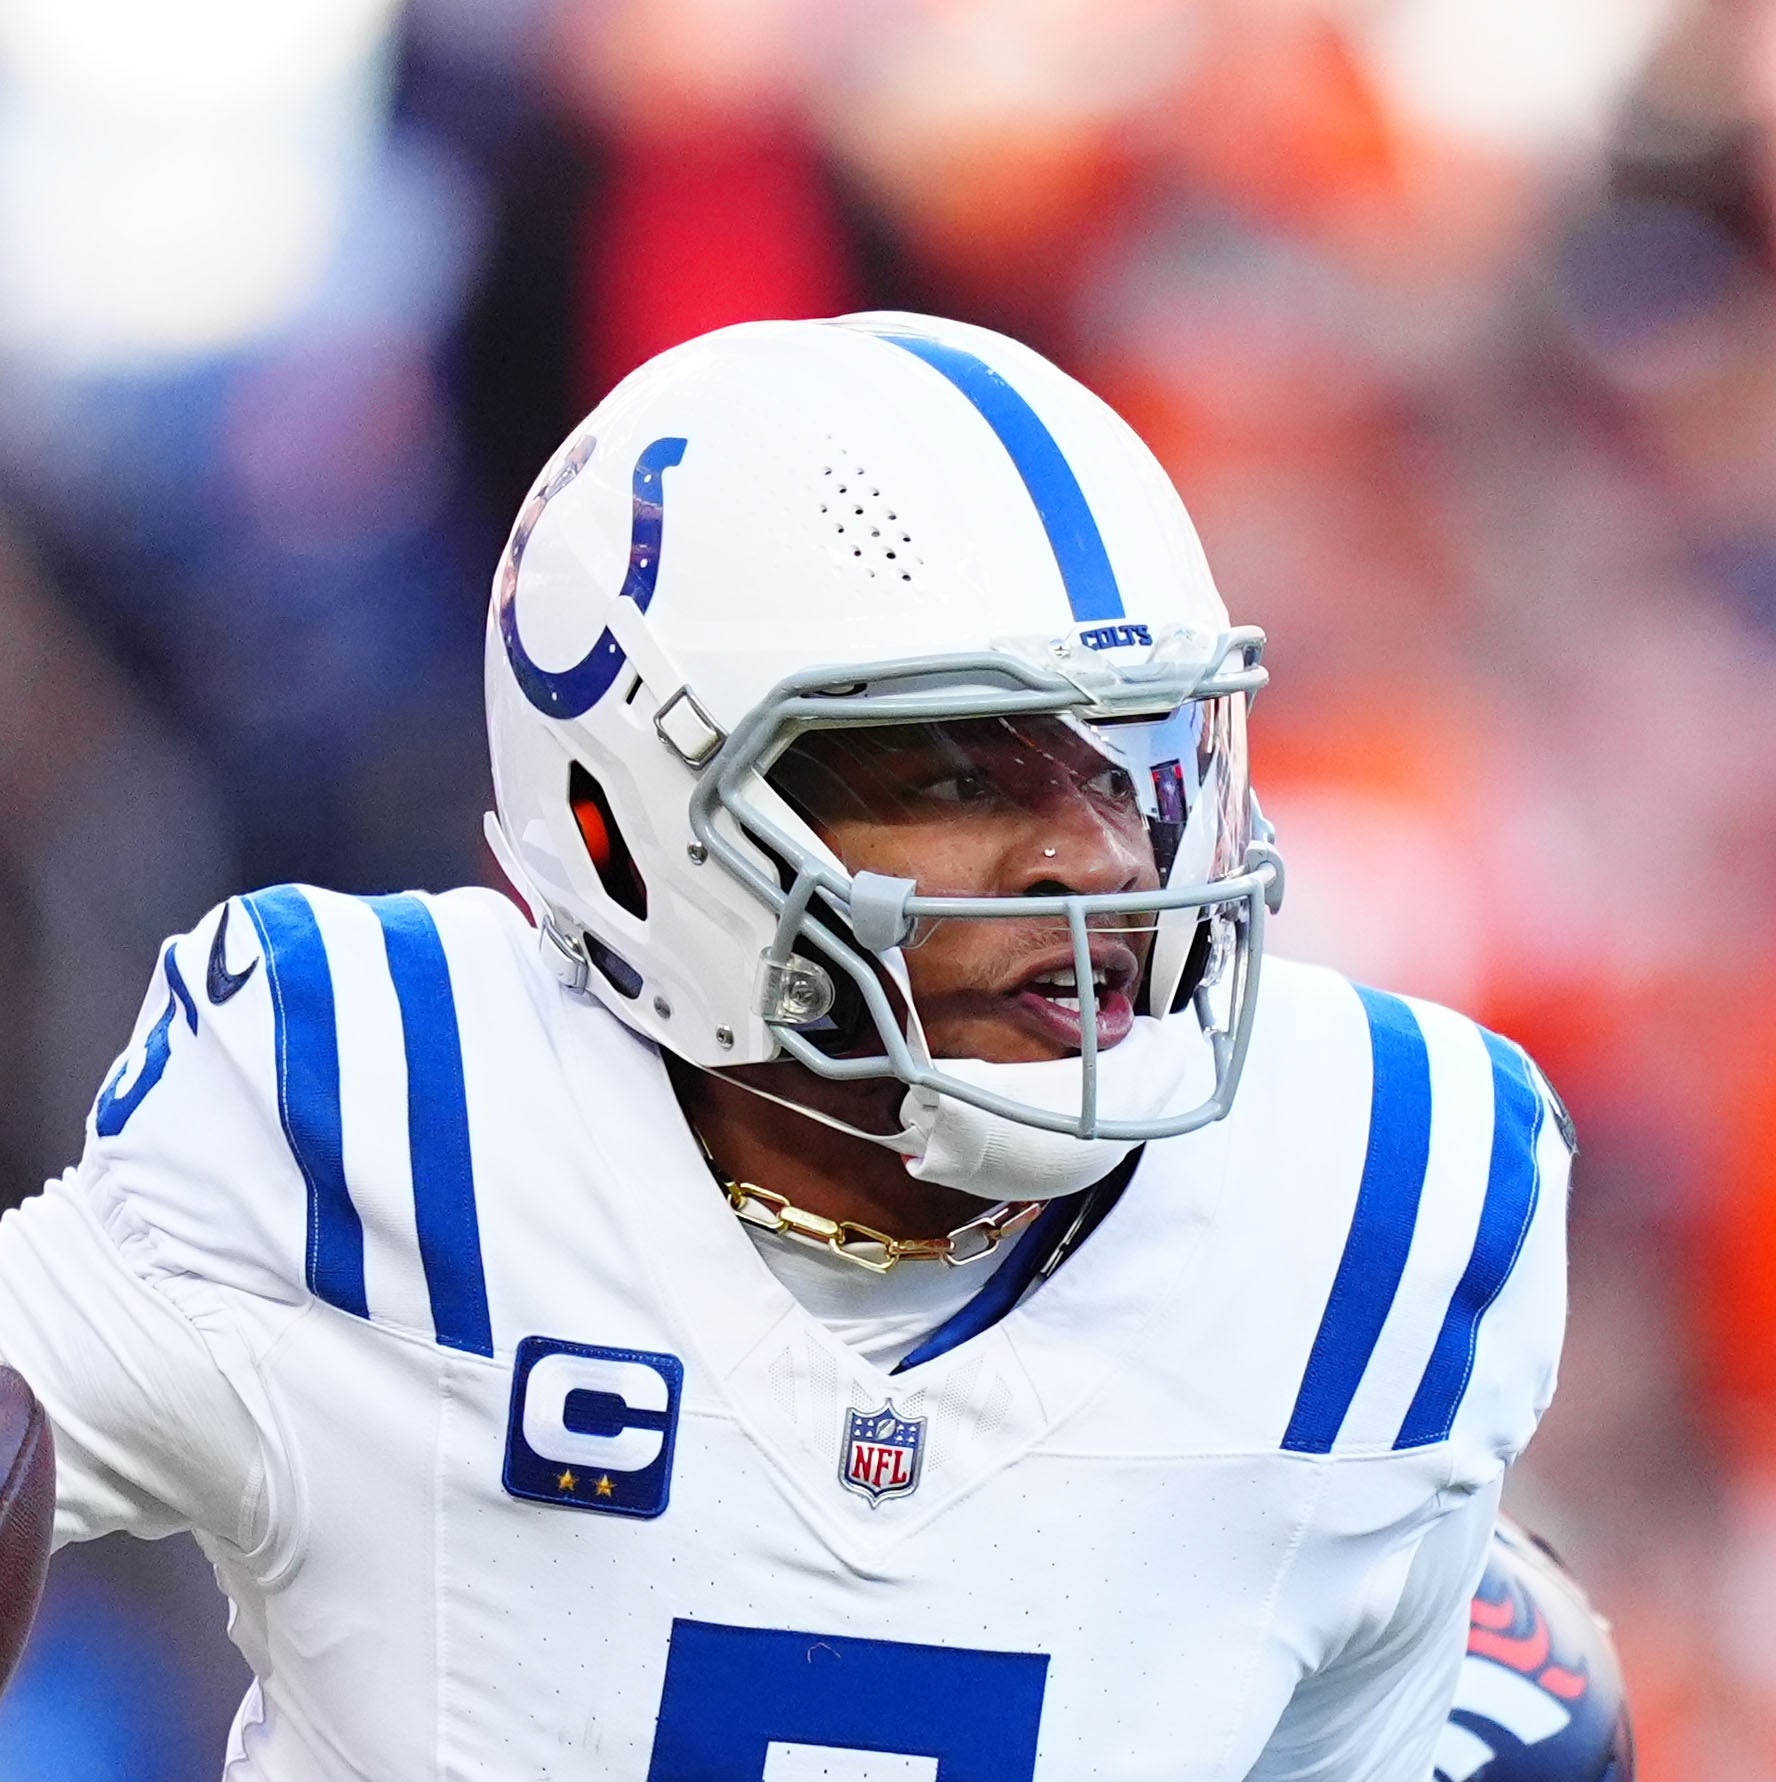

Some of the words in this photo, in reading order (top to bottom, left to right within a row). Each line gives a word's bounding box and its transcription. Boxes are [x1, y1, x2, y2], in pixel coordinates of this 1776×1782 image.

[1079, 623, 1153, 652] COLTS
[522, 1352, 669, 1472] C
[851, 1444, 908, 1489] NFL
